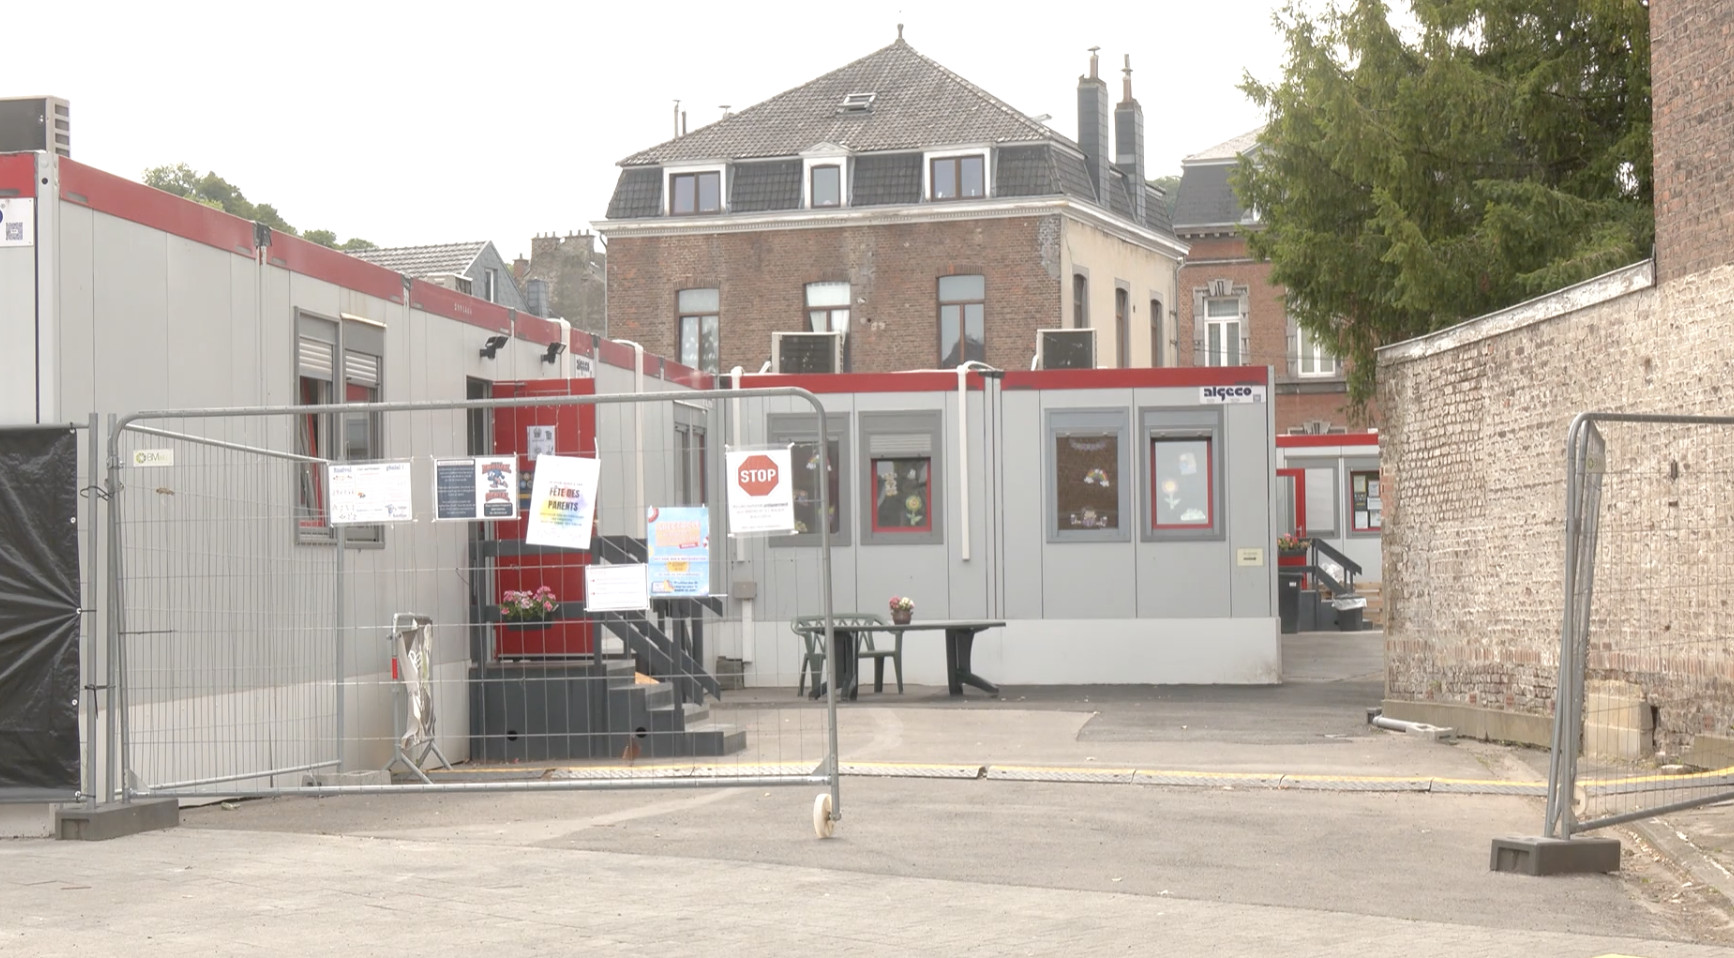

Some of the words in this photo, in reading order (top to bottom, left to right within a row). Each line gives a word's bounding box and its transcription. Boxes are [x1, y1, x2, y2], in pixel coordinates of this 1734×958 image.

[740, 468, 776, 483] STOP
[549, 485, 565, 497] FÊTE
[566, 488, 580, 498] DES
[547, 500, 578, 511] PARENTS
